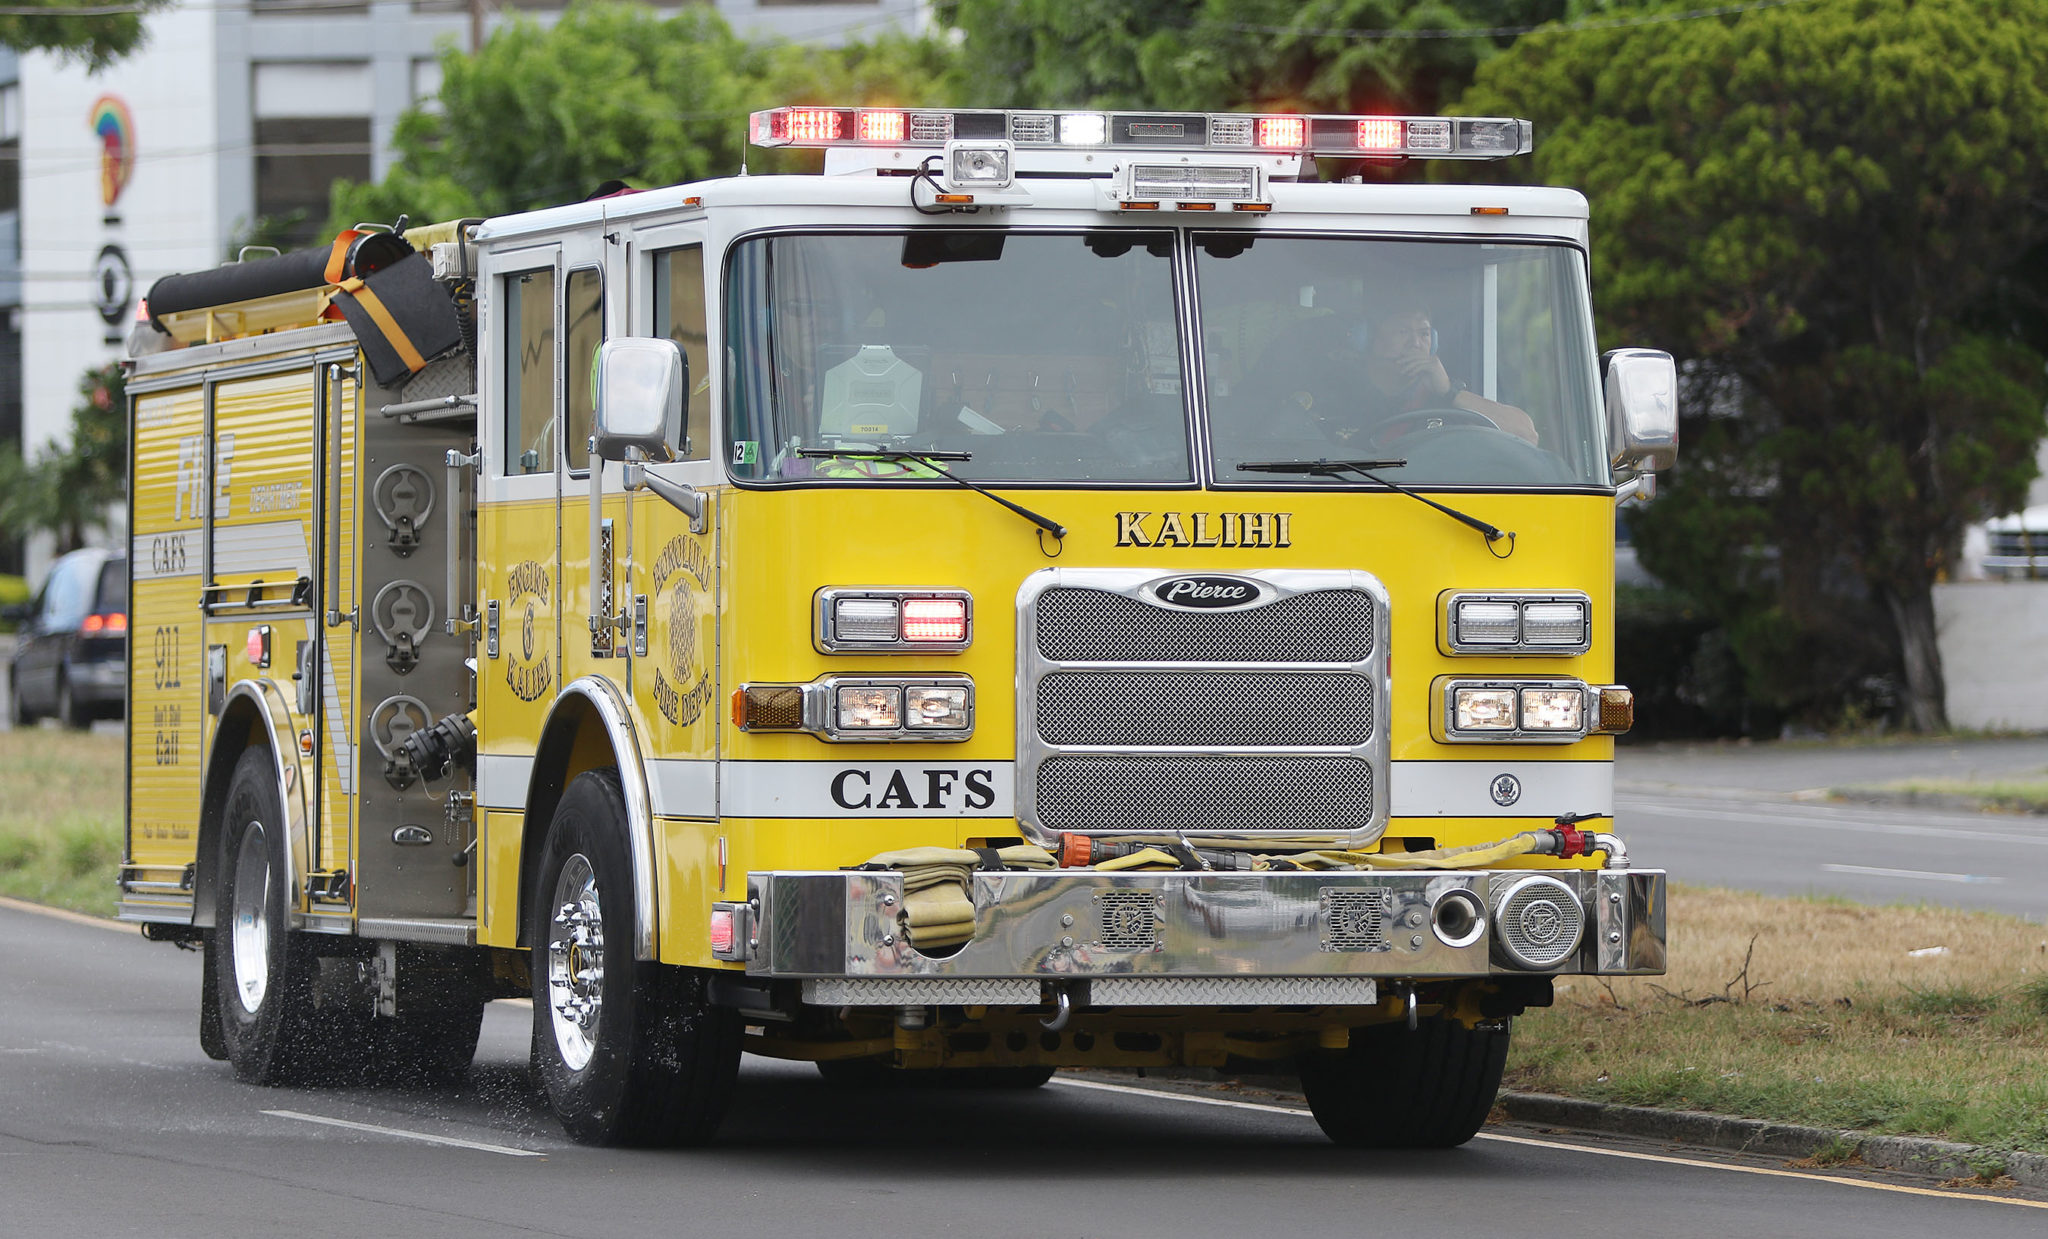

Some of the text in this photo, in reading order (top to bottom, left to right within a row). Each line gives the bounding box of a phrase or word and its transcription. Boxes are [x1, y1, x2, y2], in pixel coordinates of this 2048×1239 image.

[734, 444, 744, 461] 12
[175, 434, 235, 521] FIE
[250, 481, 302, 513] DEPARTMENT
[1115, 511, 1292, 549] KALIHI
[152, 535, 186, 574] CAFS
[653, 534, 712, 597] HONOLULU
[508, 560, 550, 607] ENGINE
[1166, 580, 1247, 602] Pierce
[522, 601, 535, 661] 6
[154, 626, 181, 690] 911
[506, 650, 552, 702] KALIHI
[653, 667, 679, 726] FIRE
[156, 730, 179, 766] Call
[830, 769, 996, 810] CAFS
